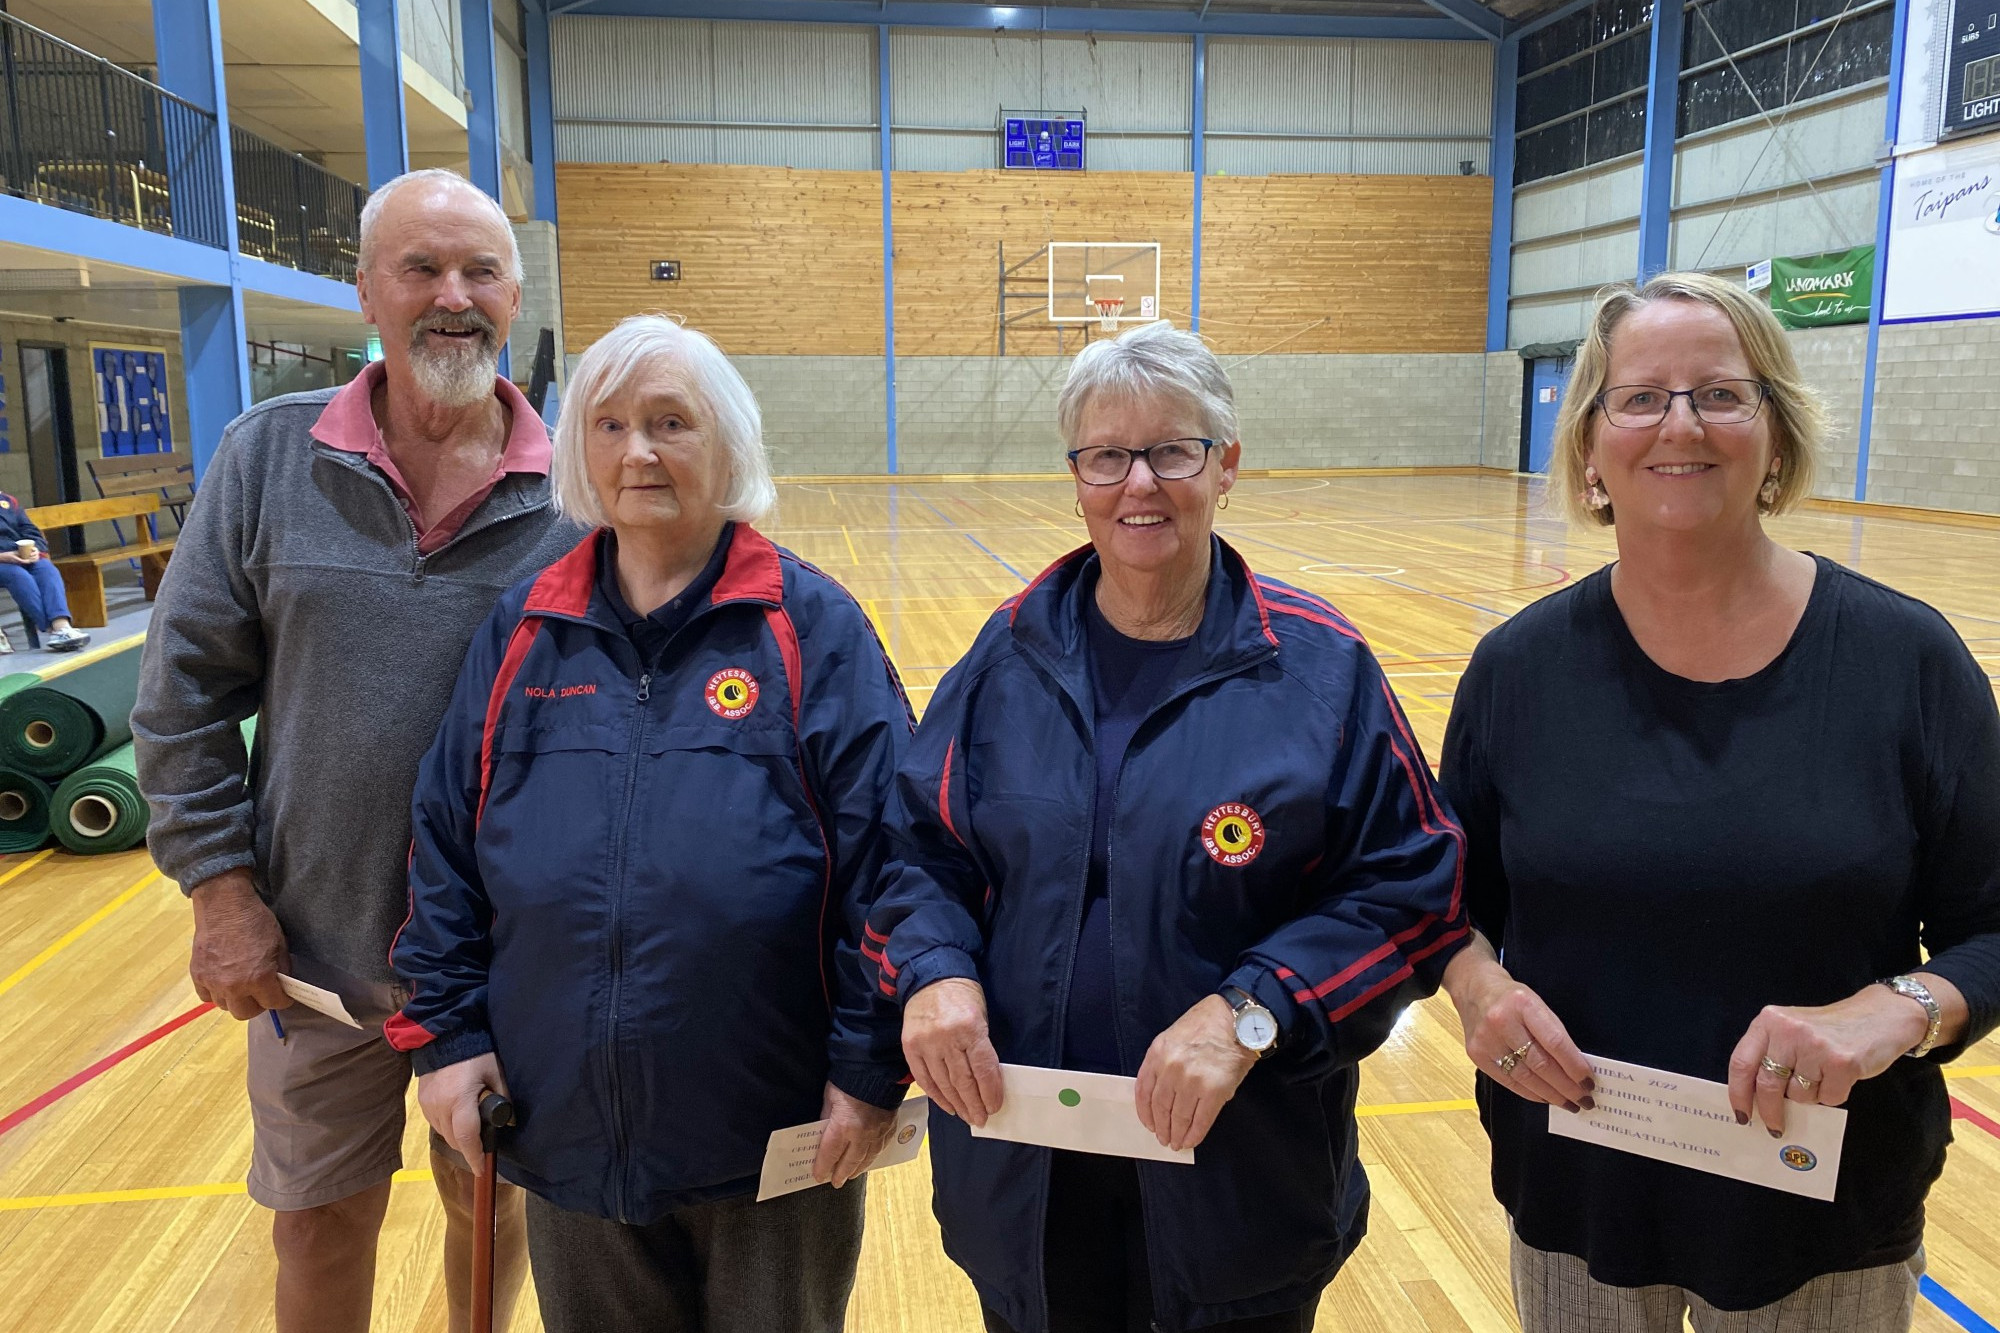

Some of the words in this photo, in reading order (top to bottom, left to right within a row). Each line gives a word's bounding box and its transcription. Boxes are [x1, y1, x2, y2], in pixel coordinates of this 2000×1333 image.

[1961, 31, 1980, 44] SUBS
[1949, 172, 1966, 180] THE
[1913, 175, 1992, 220] Taipans
[1784, 270, 1856, 292] LANDMARK
[525, 686, 556, 698] NOLA
[560, 684, 597, 698] DUNCAN
[708, 669, 757, 693] HEYTESBURY
[1204, 805, 1262, 837] HEYTESBURY
[1648, 1080, 1678, 1091] 2022
[1589, 1119, 1721, 1156] CONGRATULATIONS
